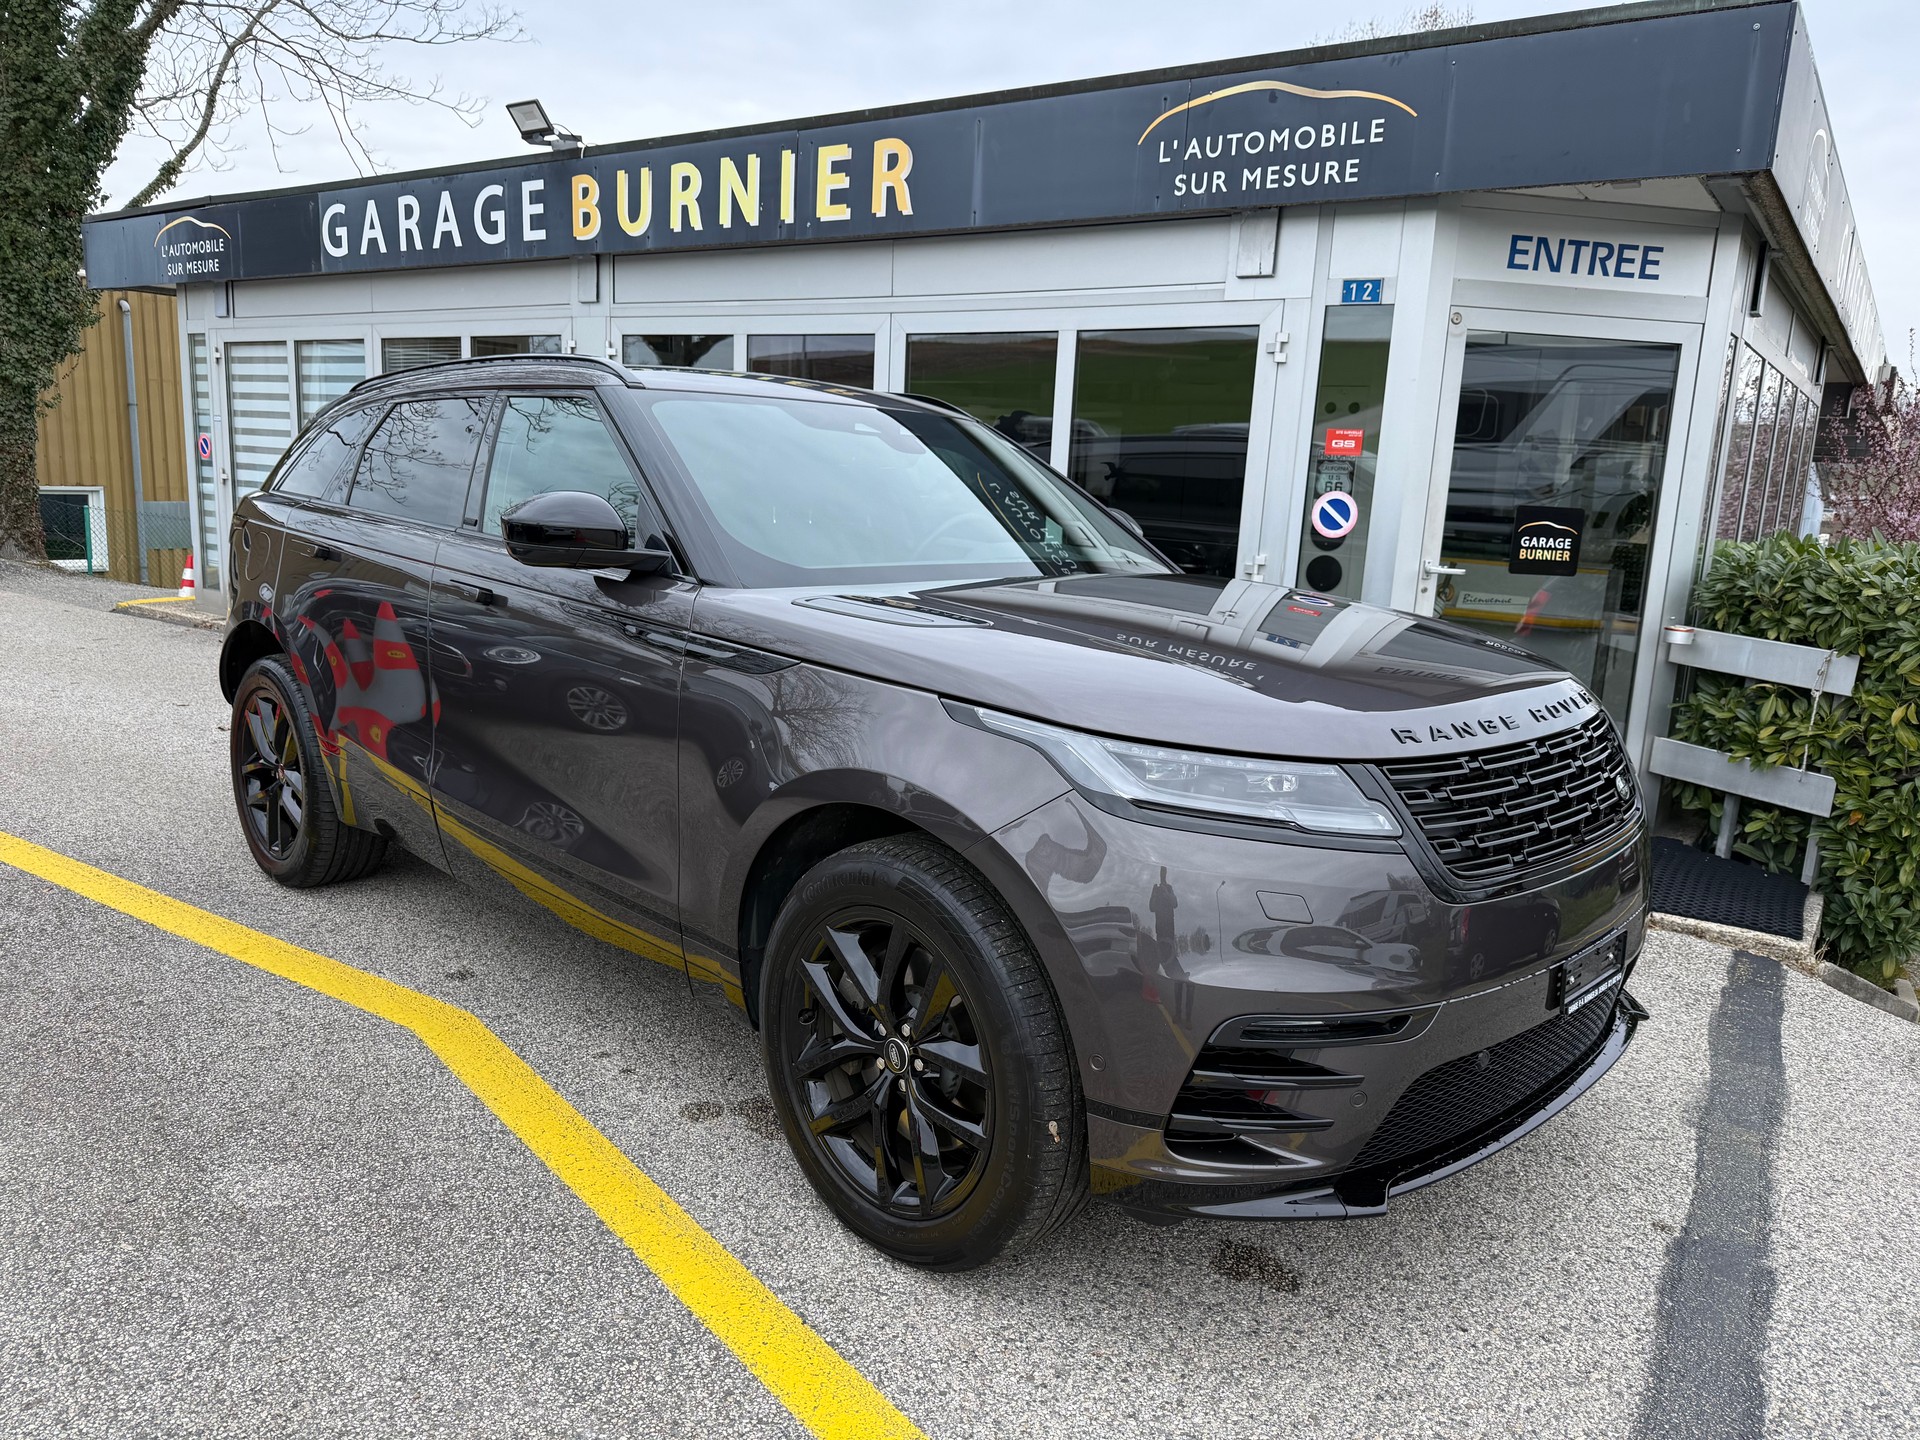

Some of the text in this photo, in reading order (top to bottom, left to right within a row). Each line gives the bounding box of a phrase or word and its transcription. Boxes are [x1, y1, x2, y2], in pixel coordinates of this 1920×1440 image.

[1158, 118, 1386, 163] L'AUTOMOBILE
[1174, 158, 1361, 196] SUR MESURE
[322, 138, 913, 258] GARAGE BURNIER
[161, 238, 225, 258] L'AUTOMOBILE
[1506, 234, 1665, 281] ENTREE
[167, 259, 220, 276] SUR MESURE
[1349, 282, 1373, 302] 12
[1331, 439, 1356, 448] GS
[1520, 536, 1572, 549] GARAGE
[1519, 549, 1571, 562] BURNIER
[1462, 593, 1512, 605] Bienvenue
[1390, 689, 1595, 745] RANGE ROVER
[803, 868, 877, 905] Continental
